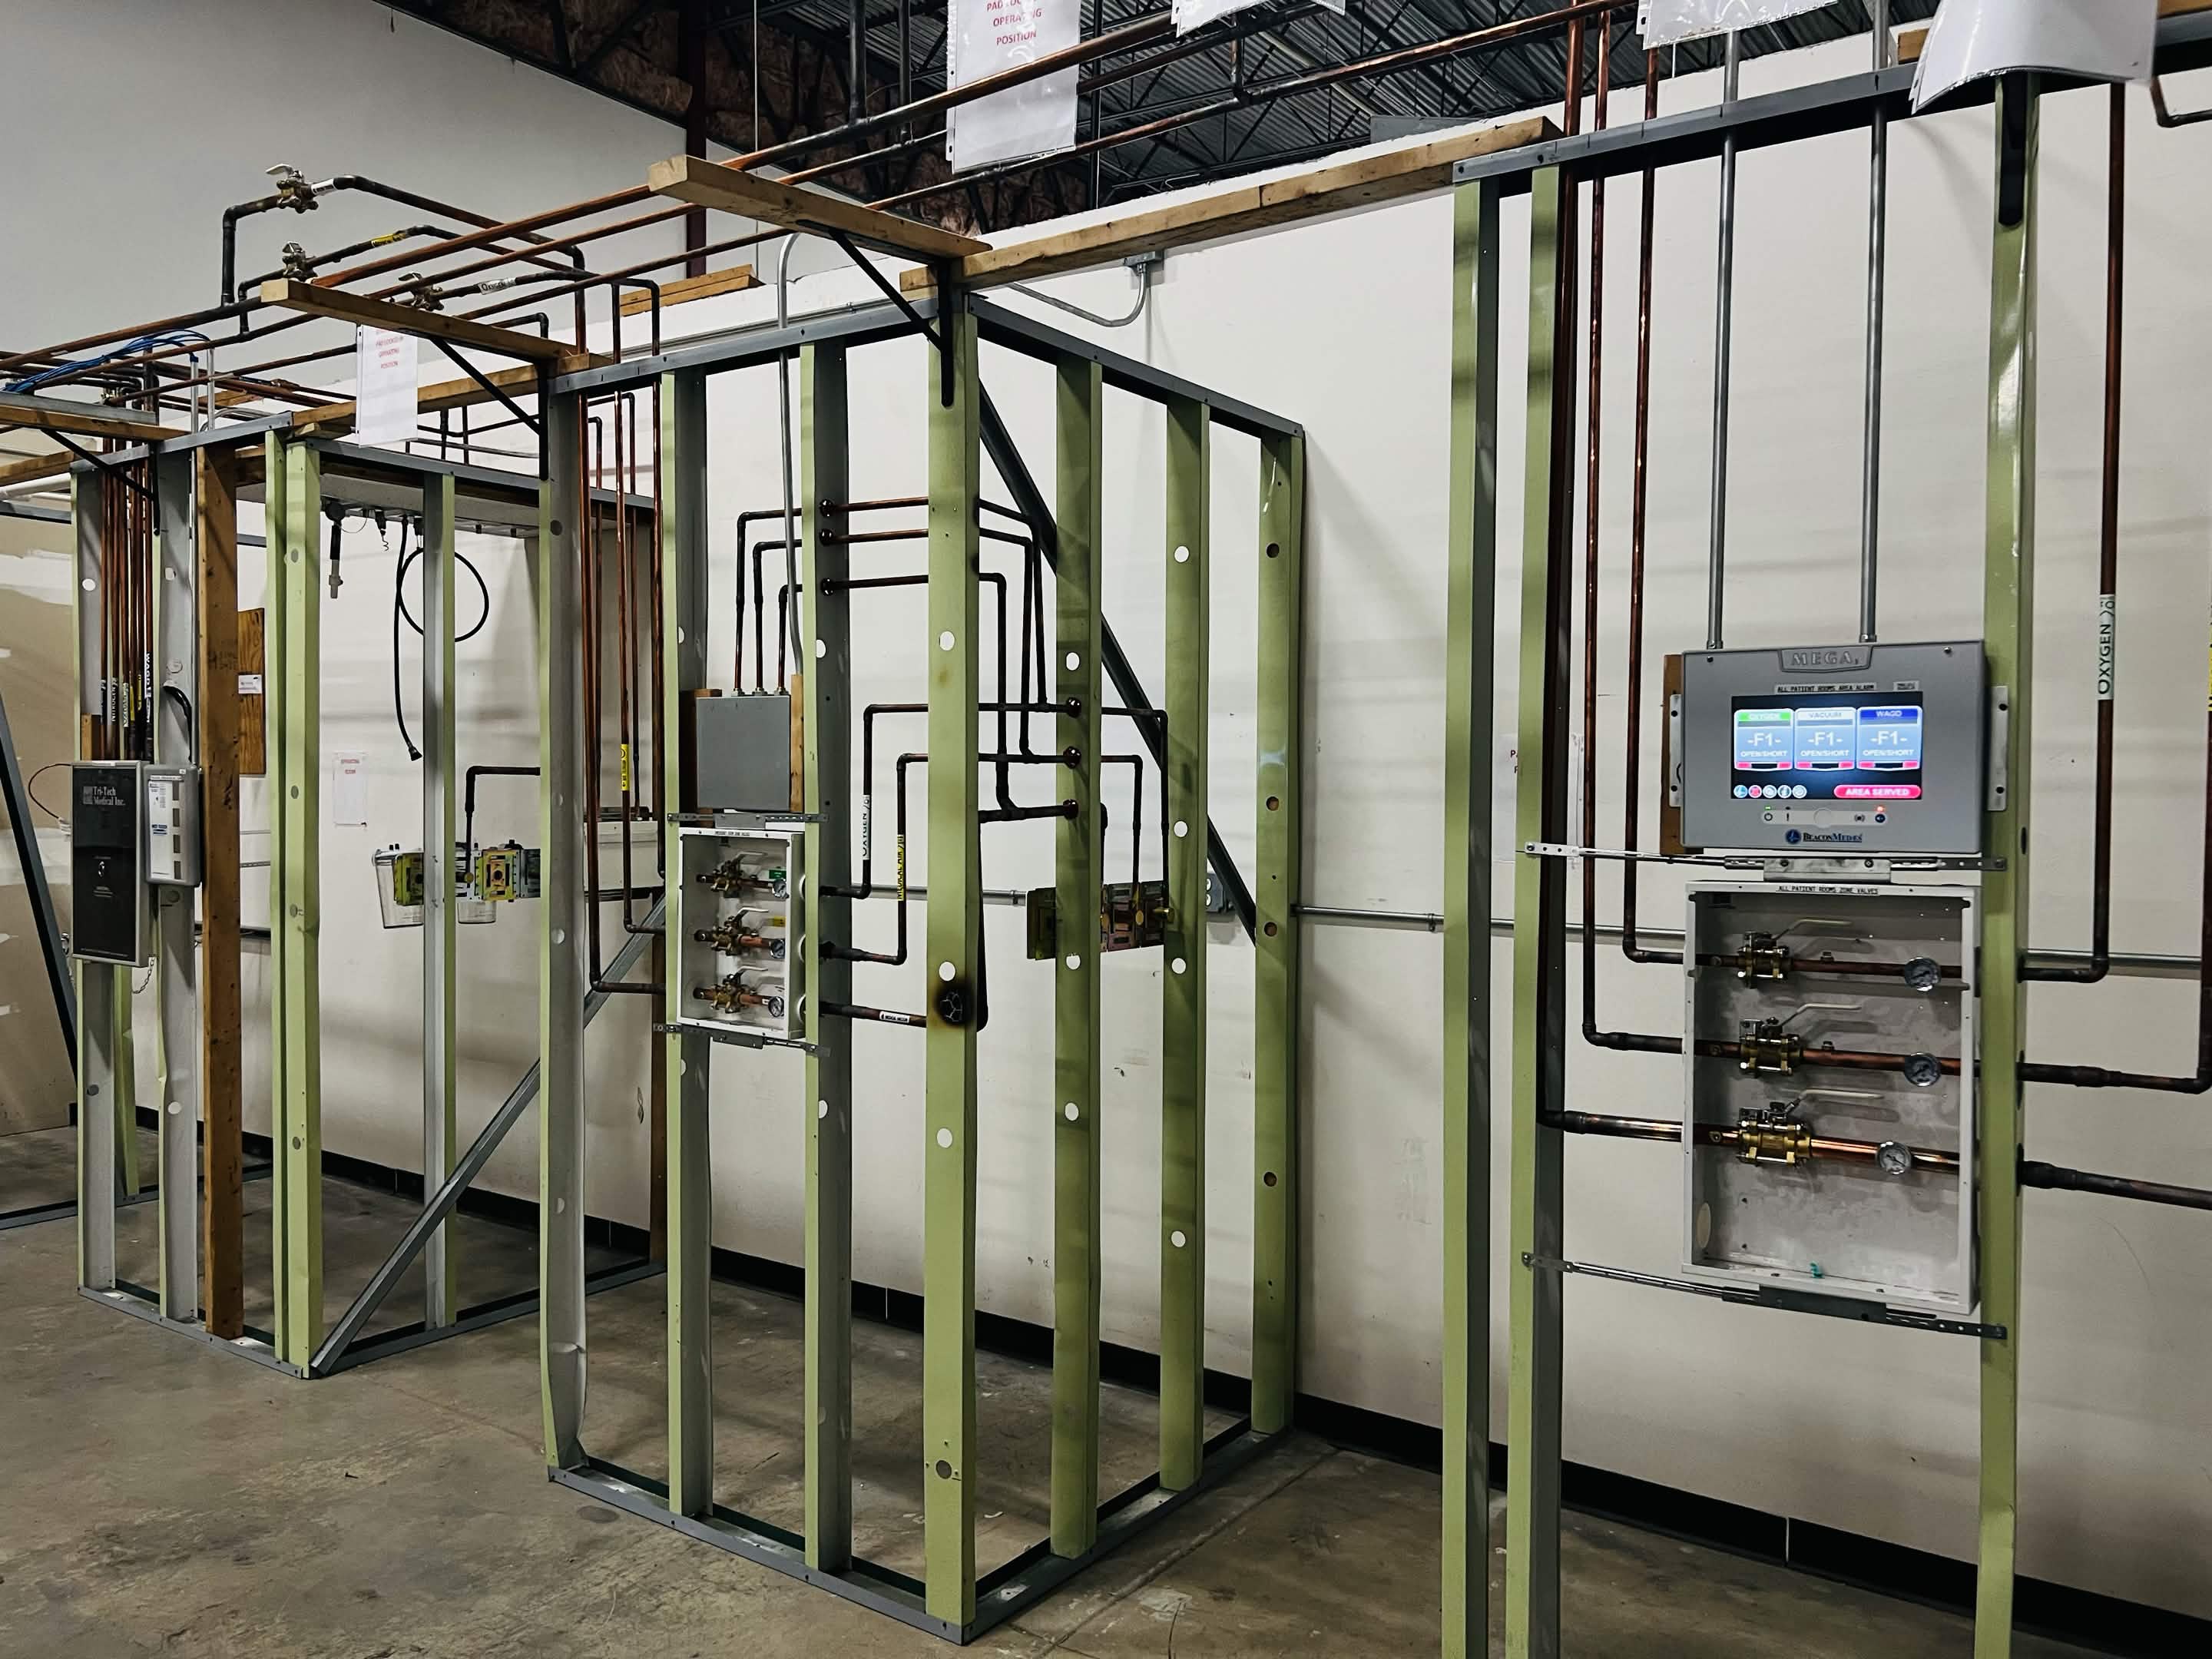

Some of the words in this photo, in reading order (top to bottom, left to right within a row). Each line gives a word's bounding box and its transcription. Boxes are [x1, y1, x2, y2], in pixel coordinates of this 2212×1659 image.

[993, 8, 1041, 27] OPERAG
[996, 31, 1037, 45] POSITION
[2098, 624, 2111, 695] OXYGEN
